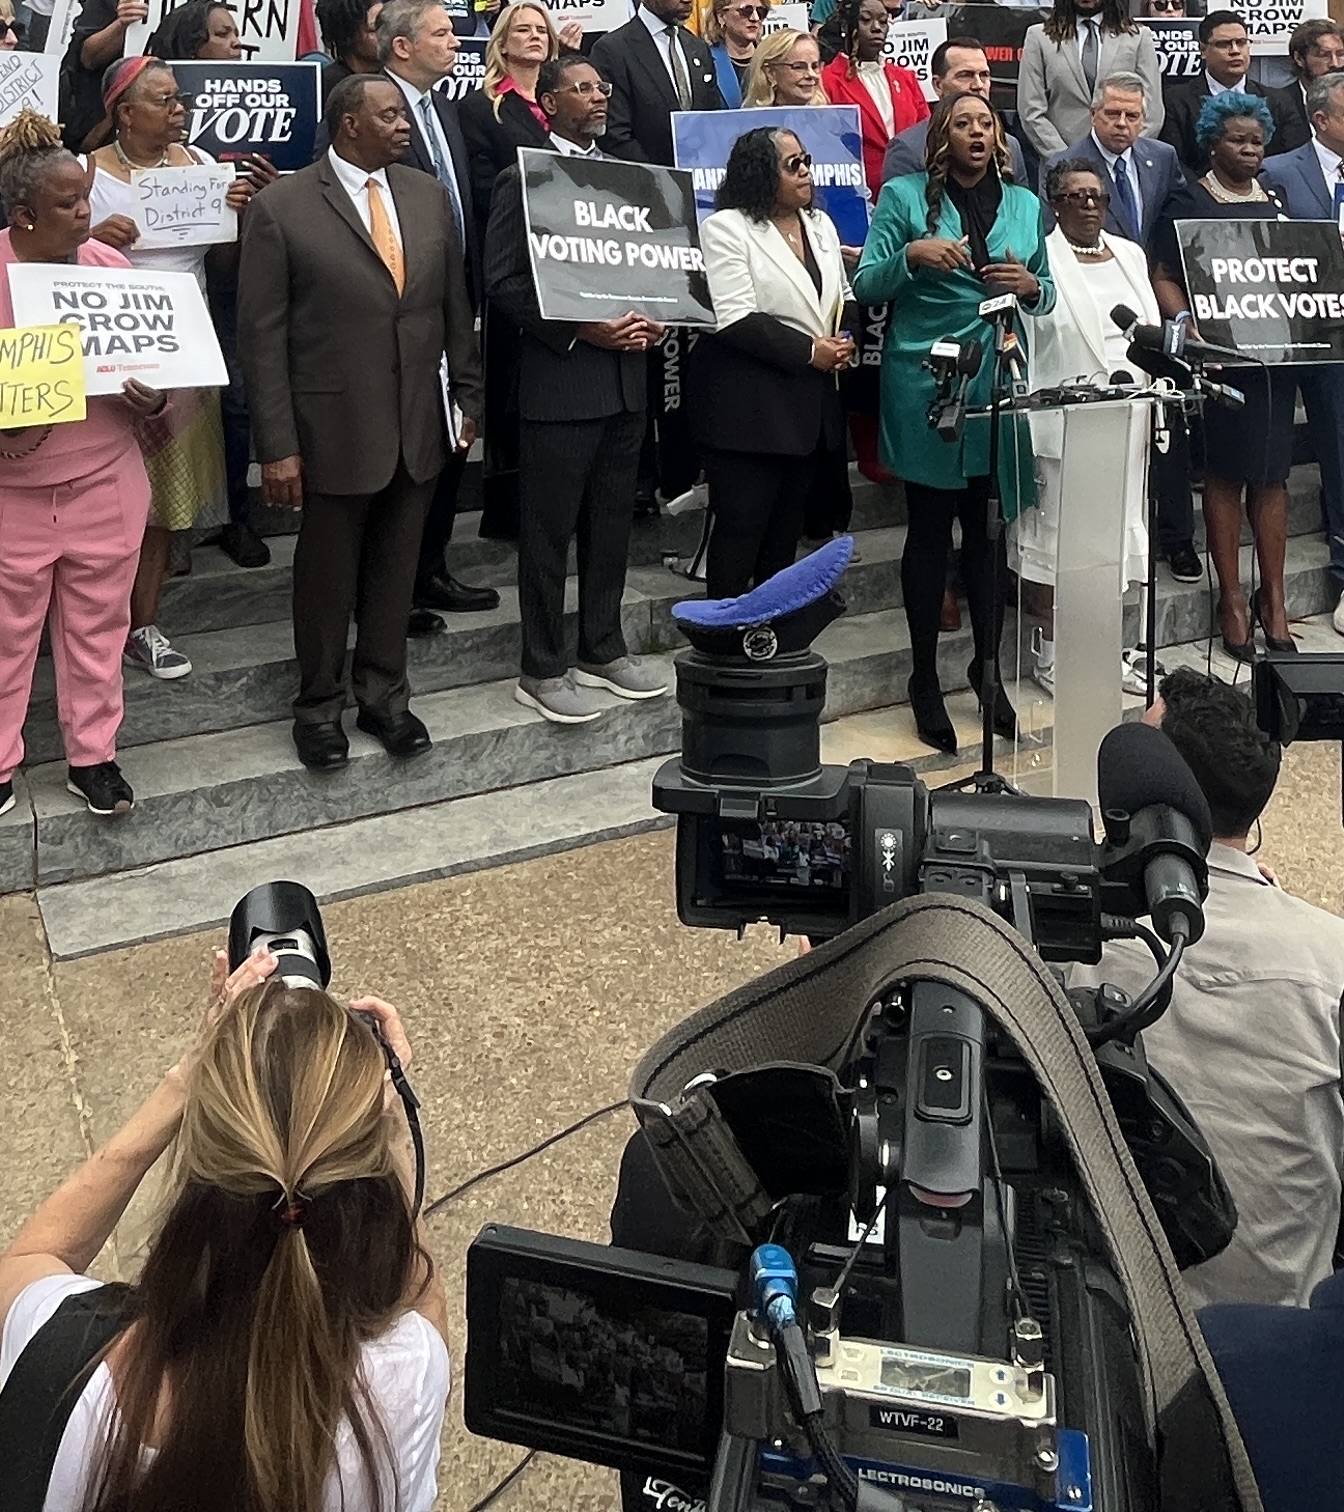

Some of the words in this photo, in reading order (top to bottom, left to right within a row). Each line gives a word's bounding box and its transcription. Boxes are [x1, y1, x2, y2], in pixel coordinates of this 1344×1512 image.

[204, 79, 282, 94] HANDS
[195, 93, 242, 108] OFF
[245, 93, 290, 108] OUR
[188, 107, 297, 145] VOTE
[138, 177, 207, 203] Standing
[207, 178, 229, 200] For
[145, 201, 206, 228] District
[210, 198, 224, 216] 9
[574, 199, 653, 233] BLACK
[531, 232, 623, 267] VOTING
[627, 238, 706, 271] POWER
[1212, 258, 1318, 284] PROTECT
[54, 290, 109, 312] NO
[119, 293, 174, 314] JIM
[1196, 293, 1282, 321] BLACK
[96, 363, 116, 373] ACLU
[118, 363, 160, 372] Tennessee
[661, 327, 682, 412] POWER
[879, 1410, 944, 1432] WTVF-22
